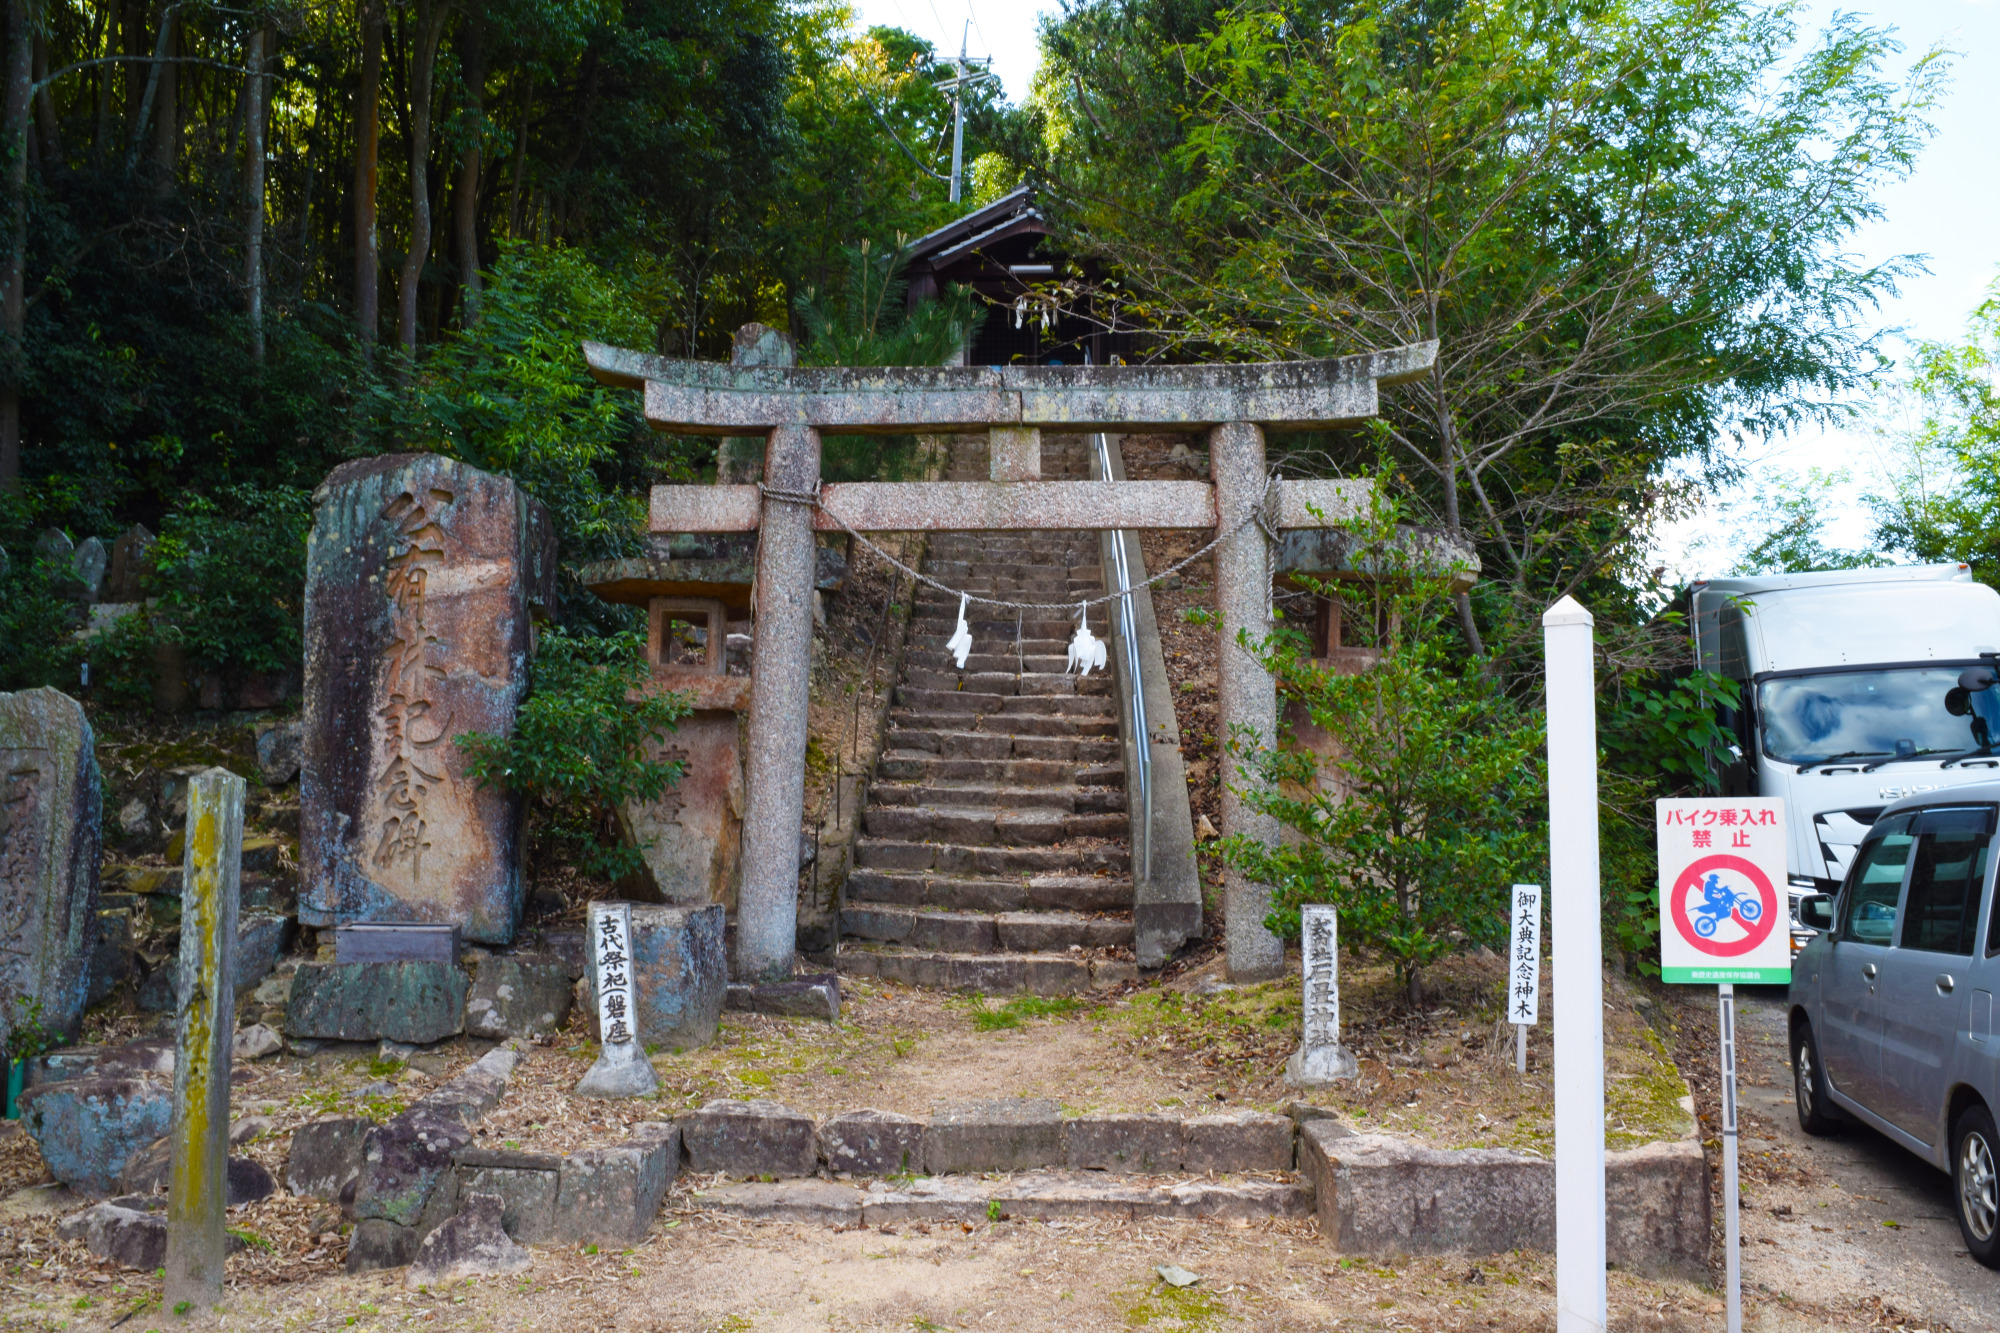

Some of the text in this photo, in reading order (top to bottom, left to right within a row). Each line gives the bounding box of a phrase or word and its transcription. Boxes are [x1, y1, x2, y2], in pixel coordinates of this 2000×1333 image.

[1879, 784, 1947, 799] ISU
[1665, 808, 1777, 827] バイク乗入れ
[1692, 829, 1751, 848] 禁止
[1514, 891, 1537, 1018] 御大典記念神木
